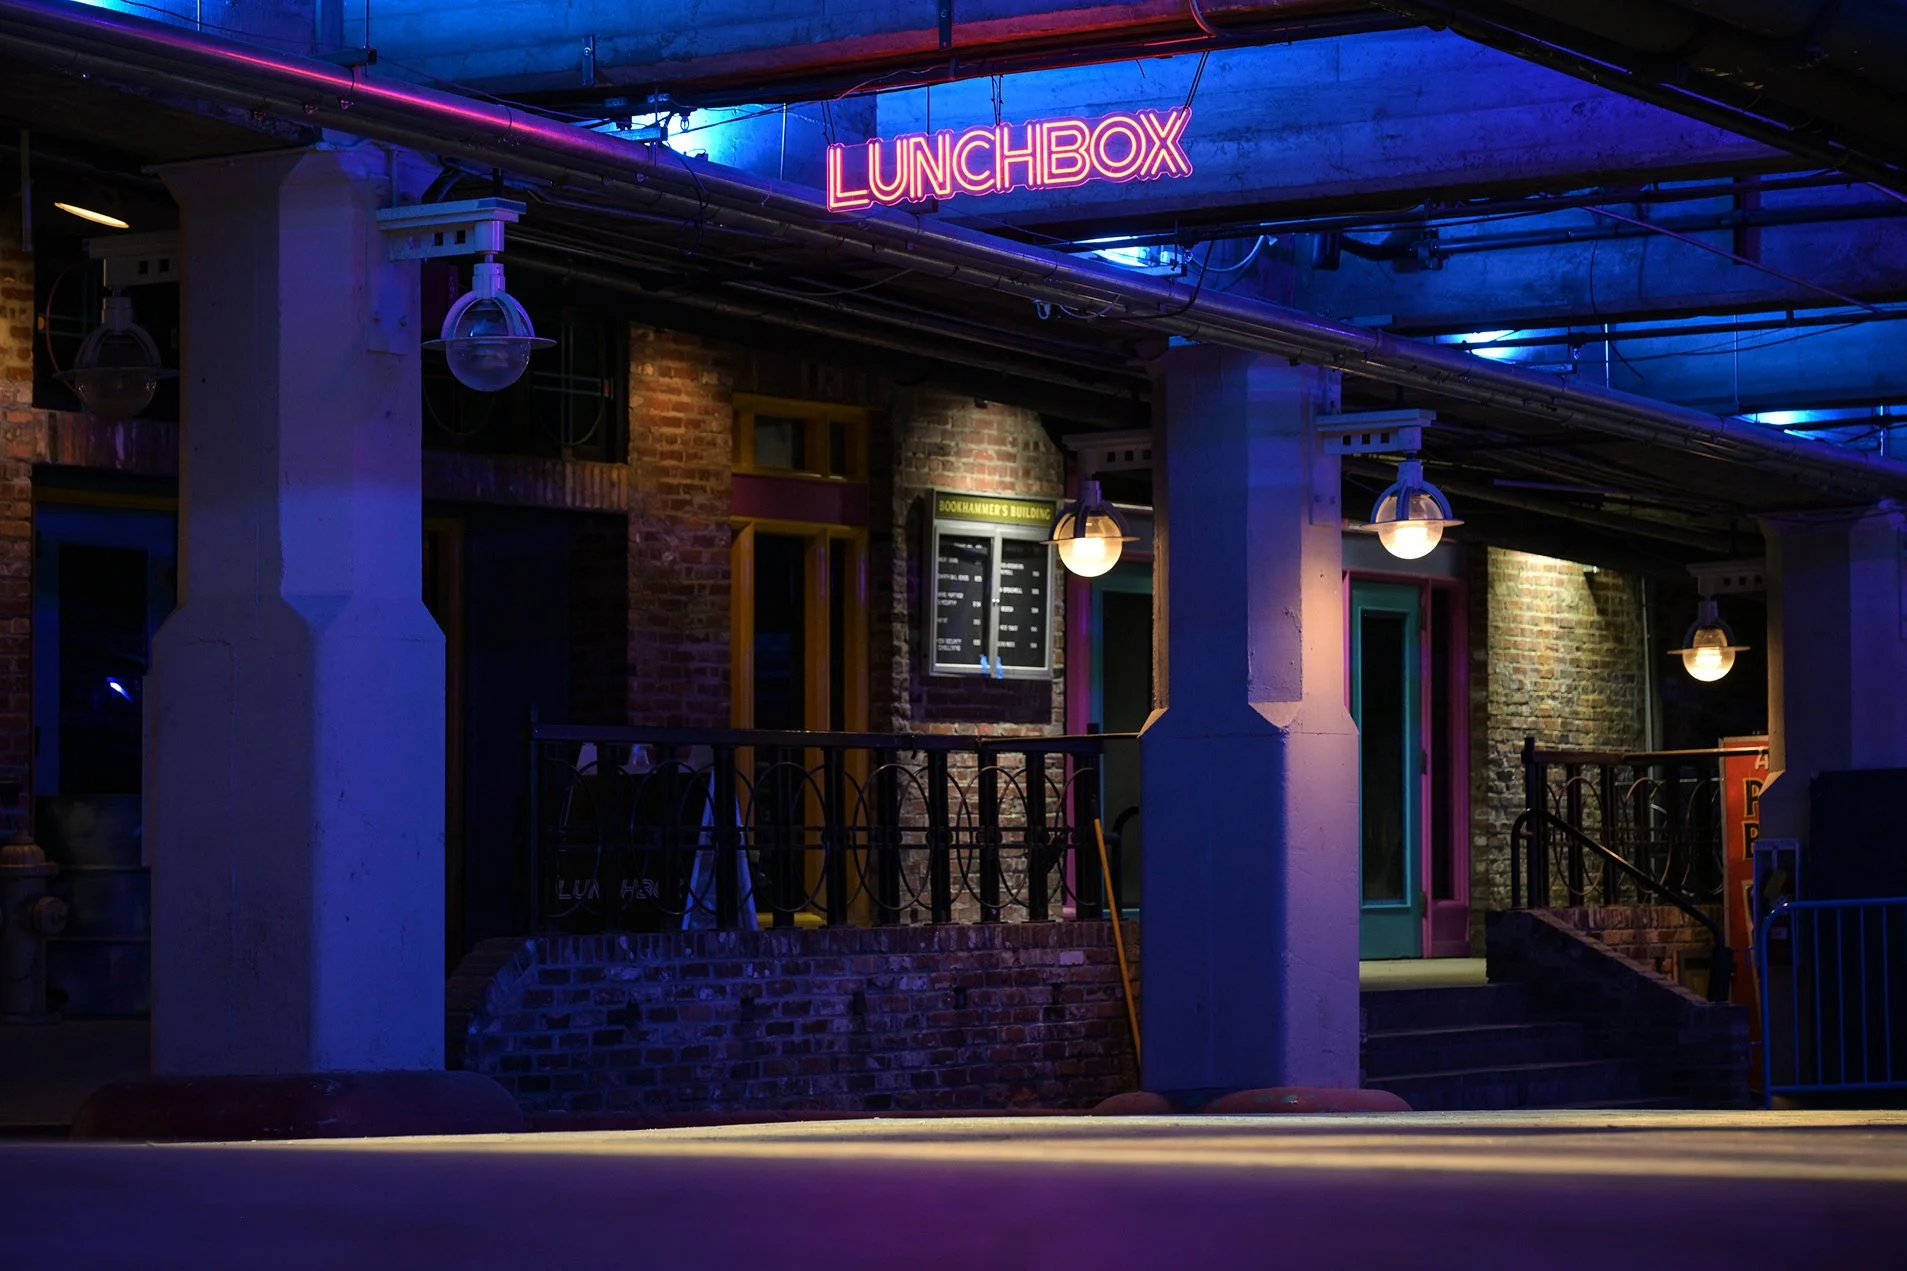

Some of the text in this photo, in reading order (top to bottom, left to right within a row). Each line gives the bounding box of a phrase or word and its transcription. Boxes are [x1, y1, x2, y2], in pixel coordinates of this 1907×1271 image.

[828, 108, 1192, 211] LUNCHBOX
[939, 499, 1051, 520] BOOKHAMMER'S BUILDING
